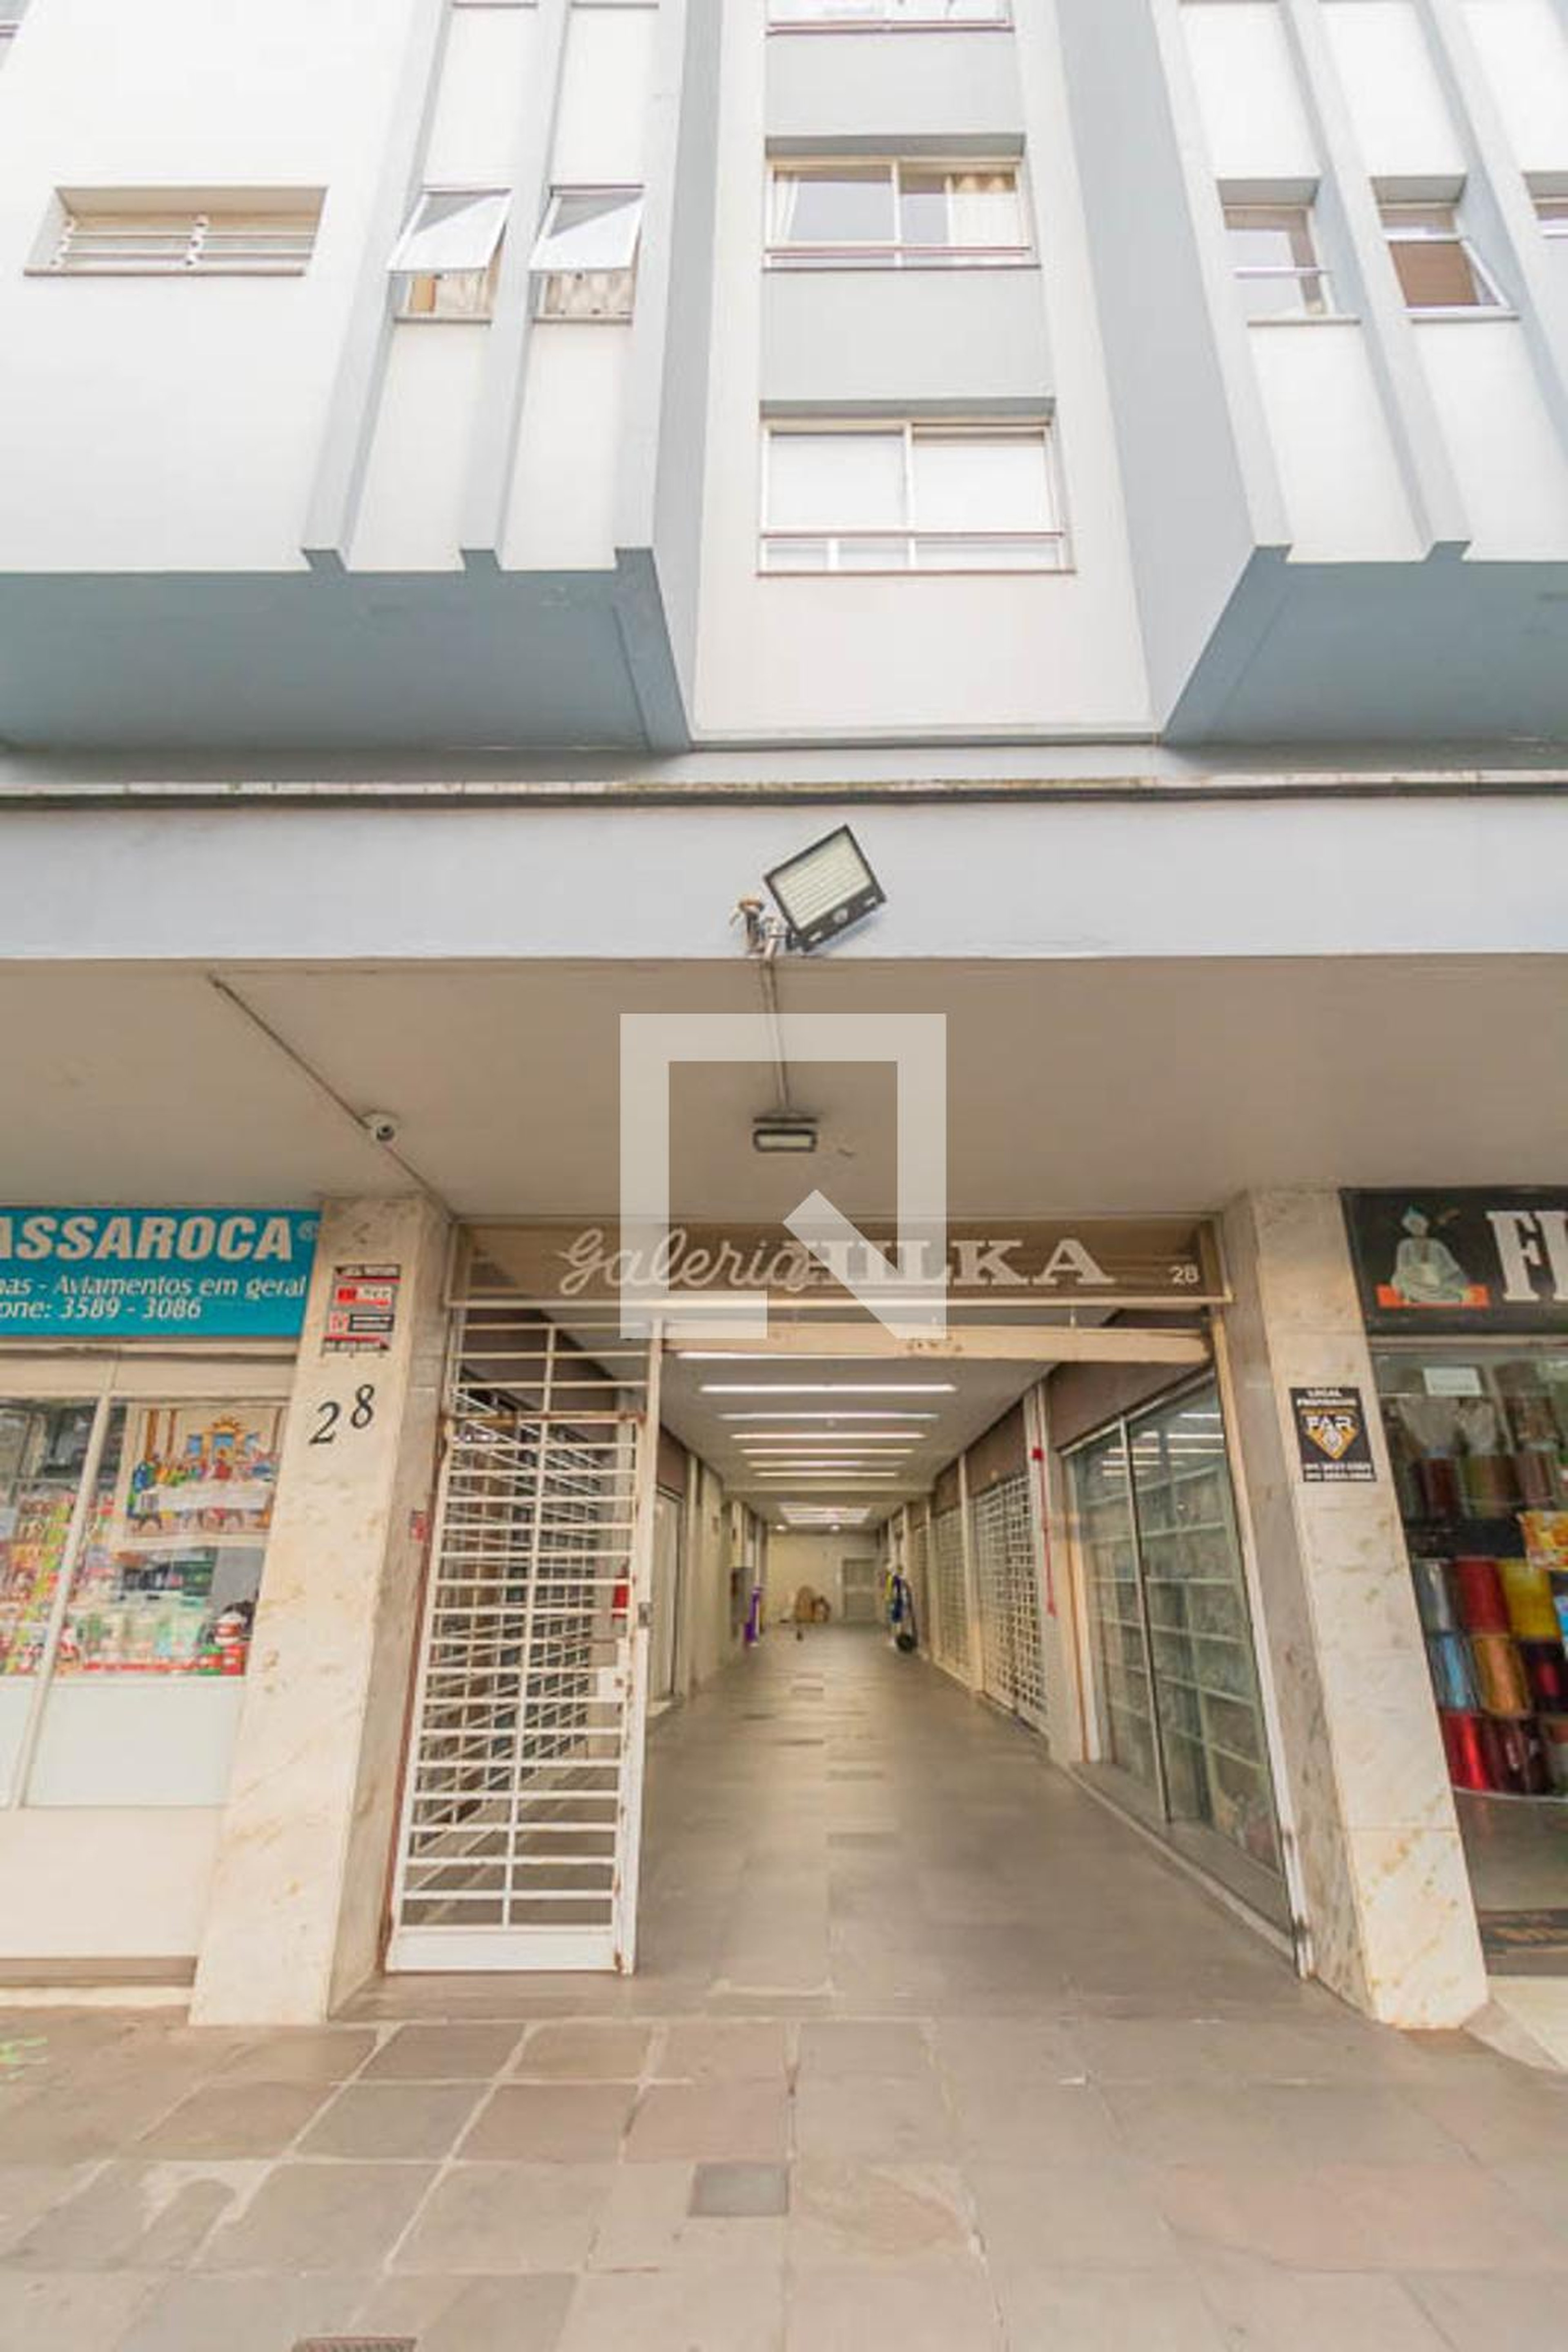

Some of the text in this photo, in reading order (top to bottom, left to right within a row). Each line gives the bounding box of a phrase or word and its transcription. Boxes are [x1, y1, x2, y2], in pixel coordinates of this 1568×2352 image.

[559, 1228, 1118, 1295] Galeria HILKA
[1168, 1265, 1199, 1285] 28
[52, 1274, 194, 1296] Aviamentos
[199, 1277, 239, 1297] em
[246, 1274, 307, 1301] geral
[61, 1296, 122, 1319] 3589
[142, 1296, 203, 1321] 3086
[309, 1383, 374, 1446] 28
